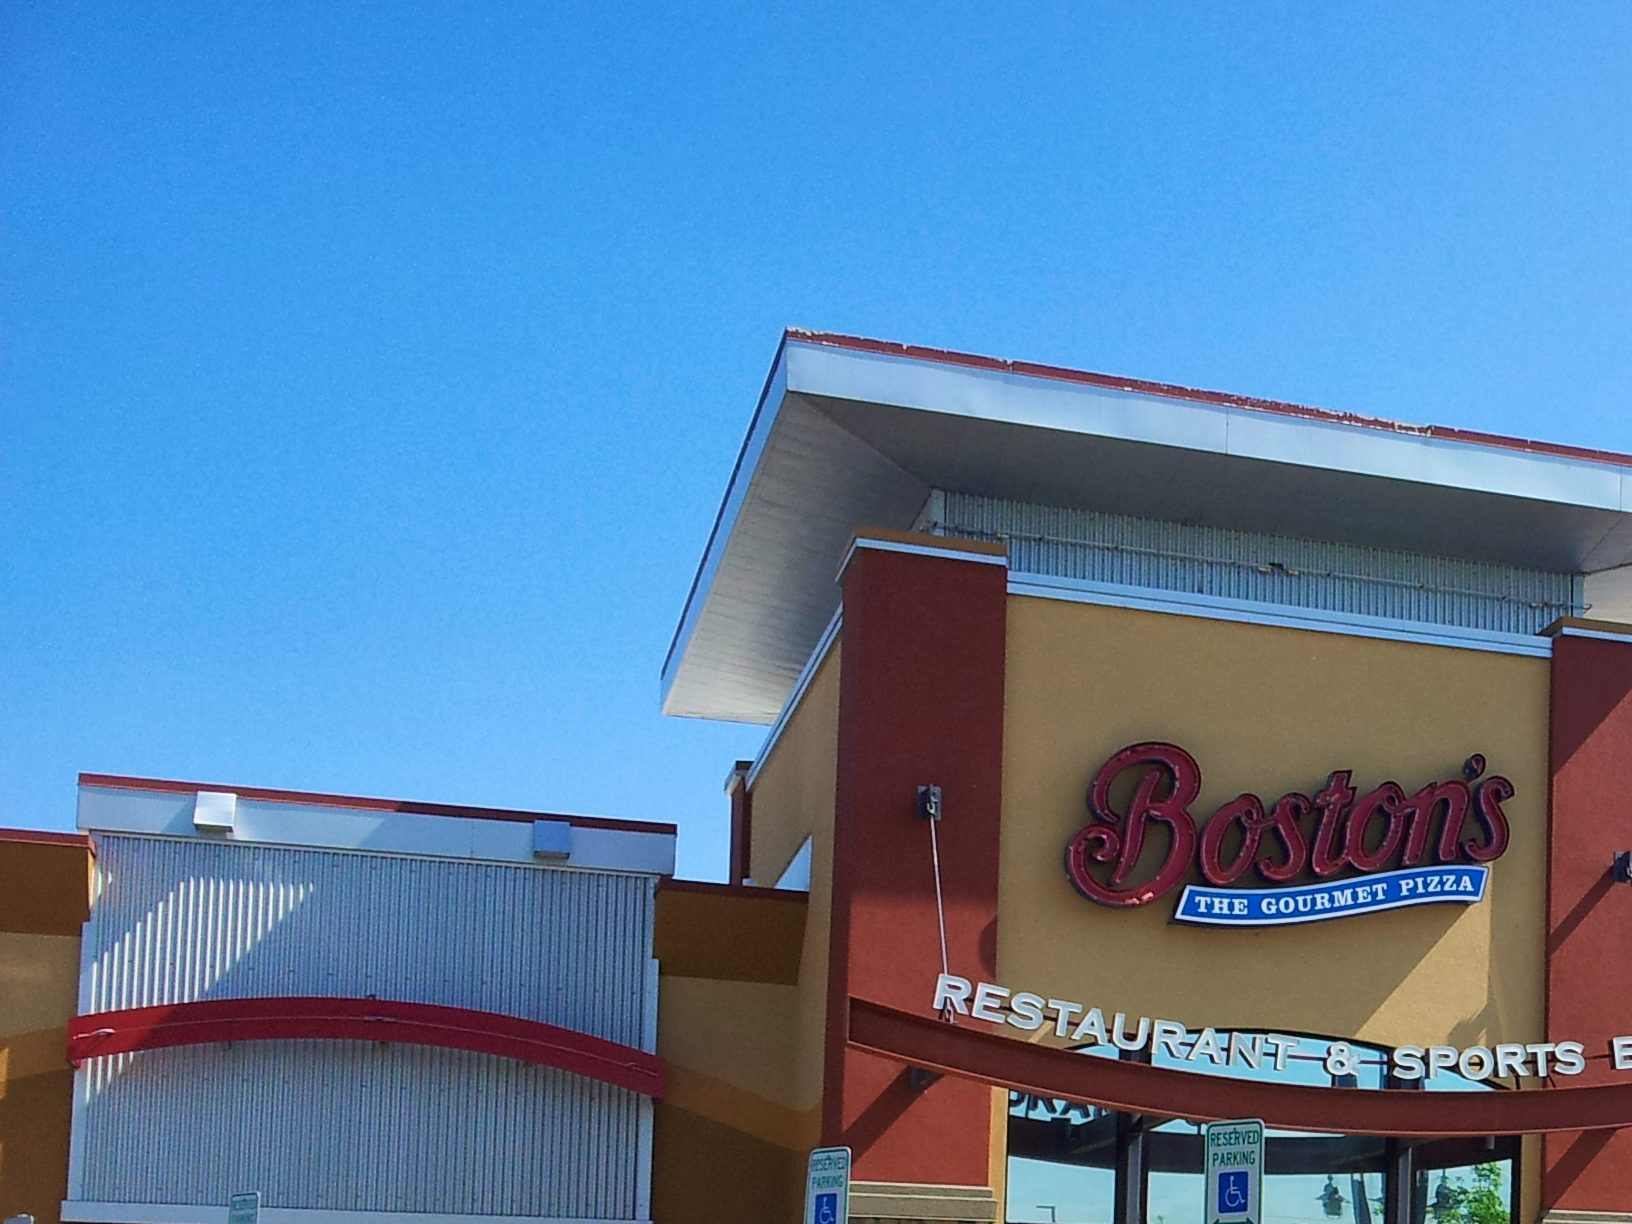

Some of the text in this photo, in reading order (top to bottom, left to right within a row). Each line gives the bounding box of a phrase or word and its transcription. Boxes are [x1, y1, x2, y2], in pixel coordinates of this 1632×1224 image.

[1065, 741, 1515, 906] Boston's
[1195, 874, 1475, 915] THE GOURMET PIZZA
[932, 973, 1300, 1071] RESTAURANT
[1326, 1041, 1361, 1077] &
[1393, 1040, 1585, 1080] SPORTS
[1210, 1130, 1259, 1147] RESERVED
[1212, 1150, 1256, 1167] PARKING
[811, 1175, 844, 1188] PARKING
